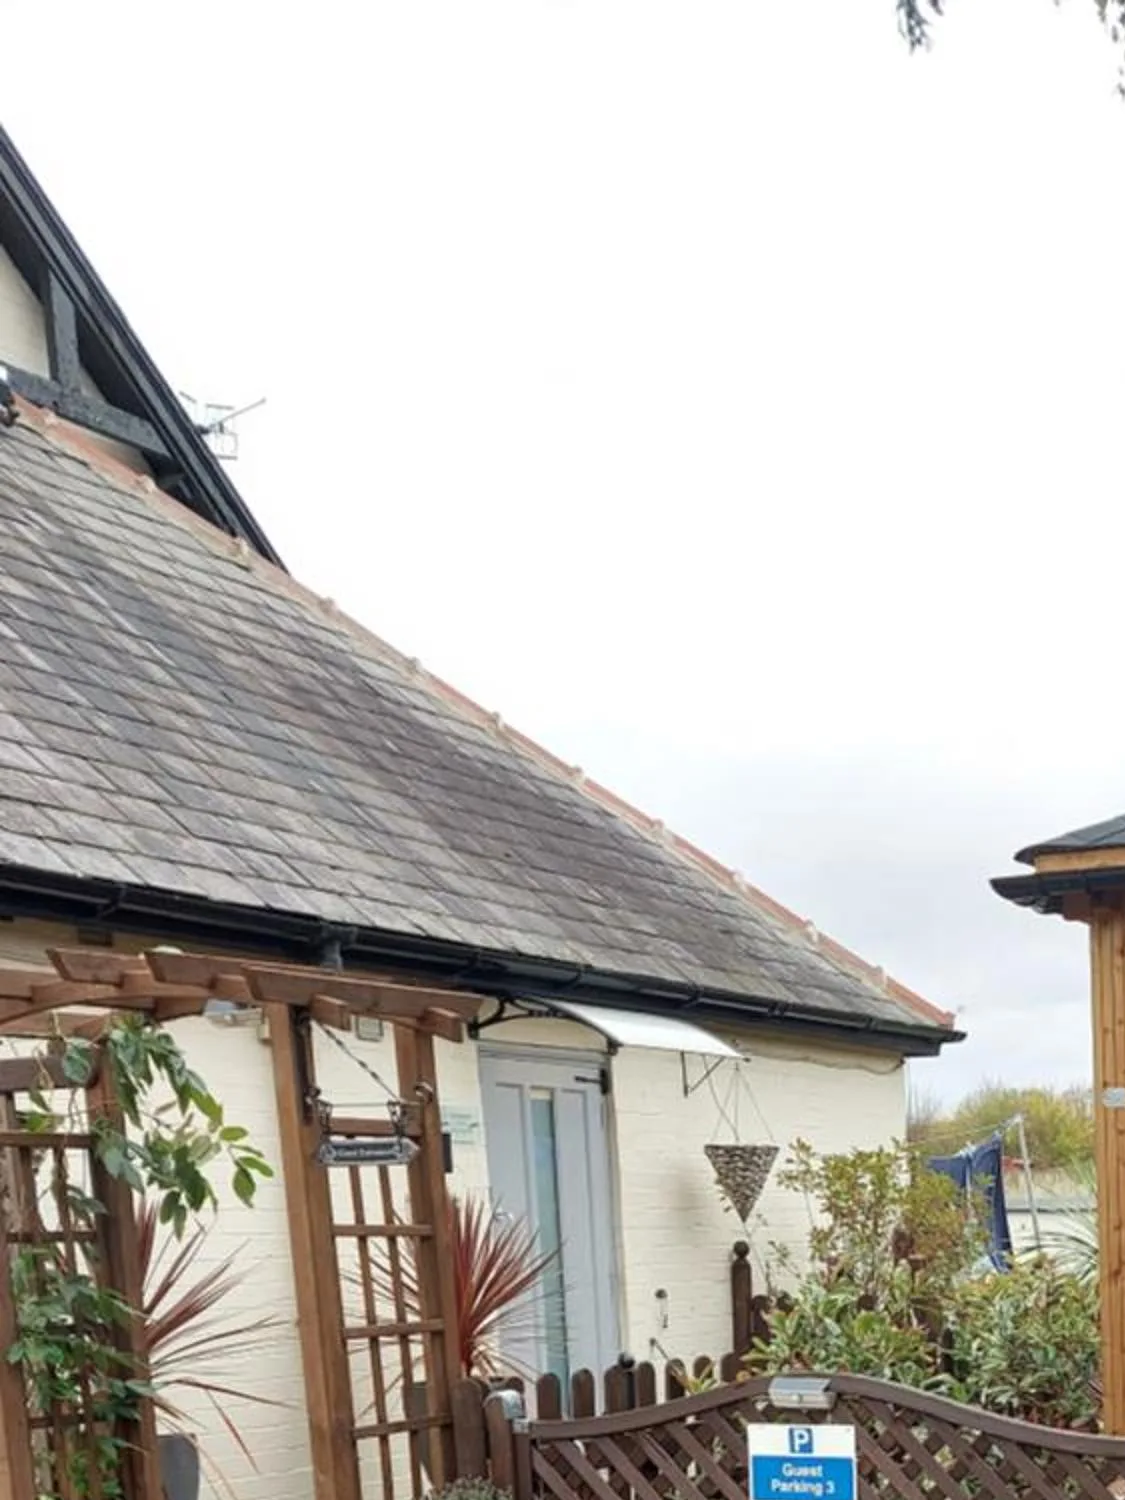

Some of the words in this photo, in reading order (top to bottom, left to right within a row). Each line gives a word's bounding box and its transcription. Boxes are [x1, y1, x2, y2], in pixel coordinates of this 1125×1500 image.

[793, 1430, 809, 1452] P
[782, 1462, 823, 1477] Guest
[771, 1478, 823, 1497] Parking
[827, 1480, 836, 1495] 3
